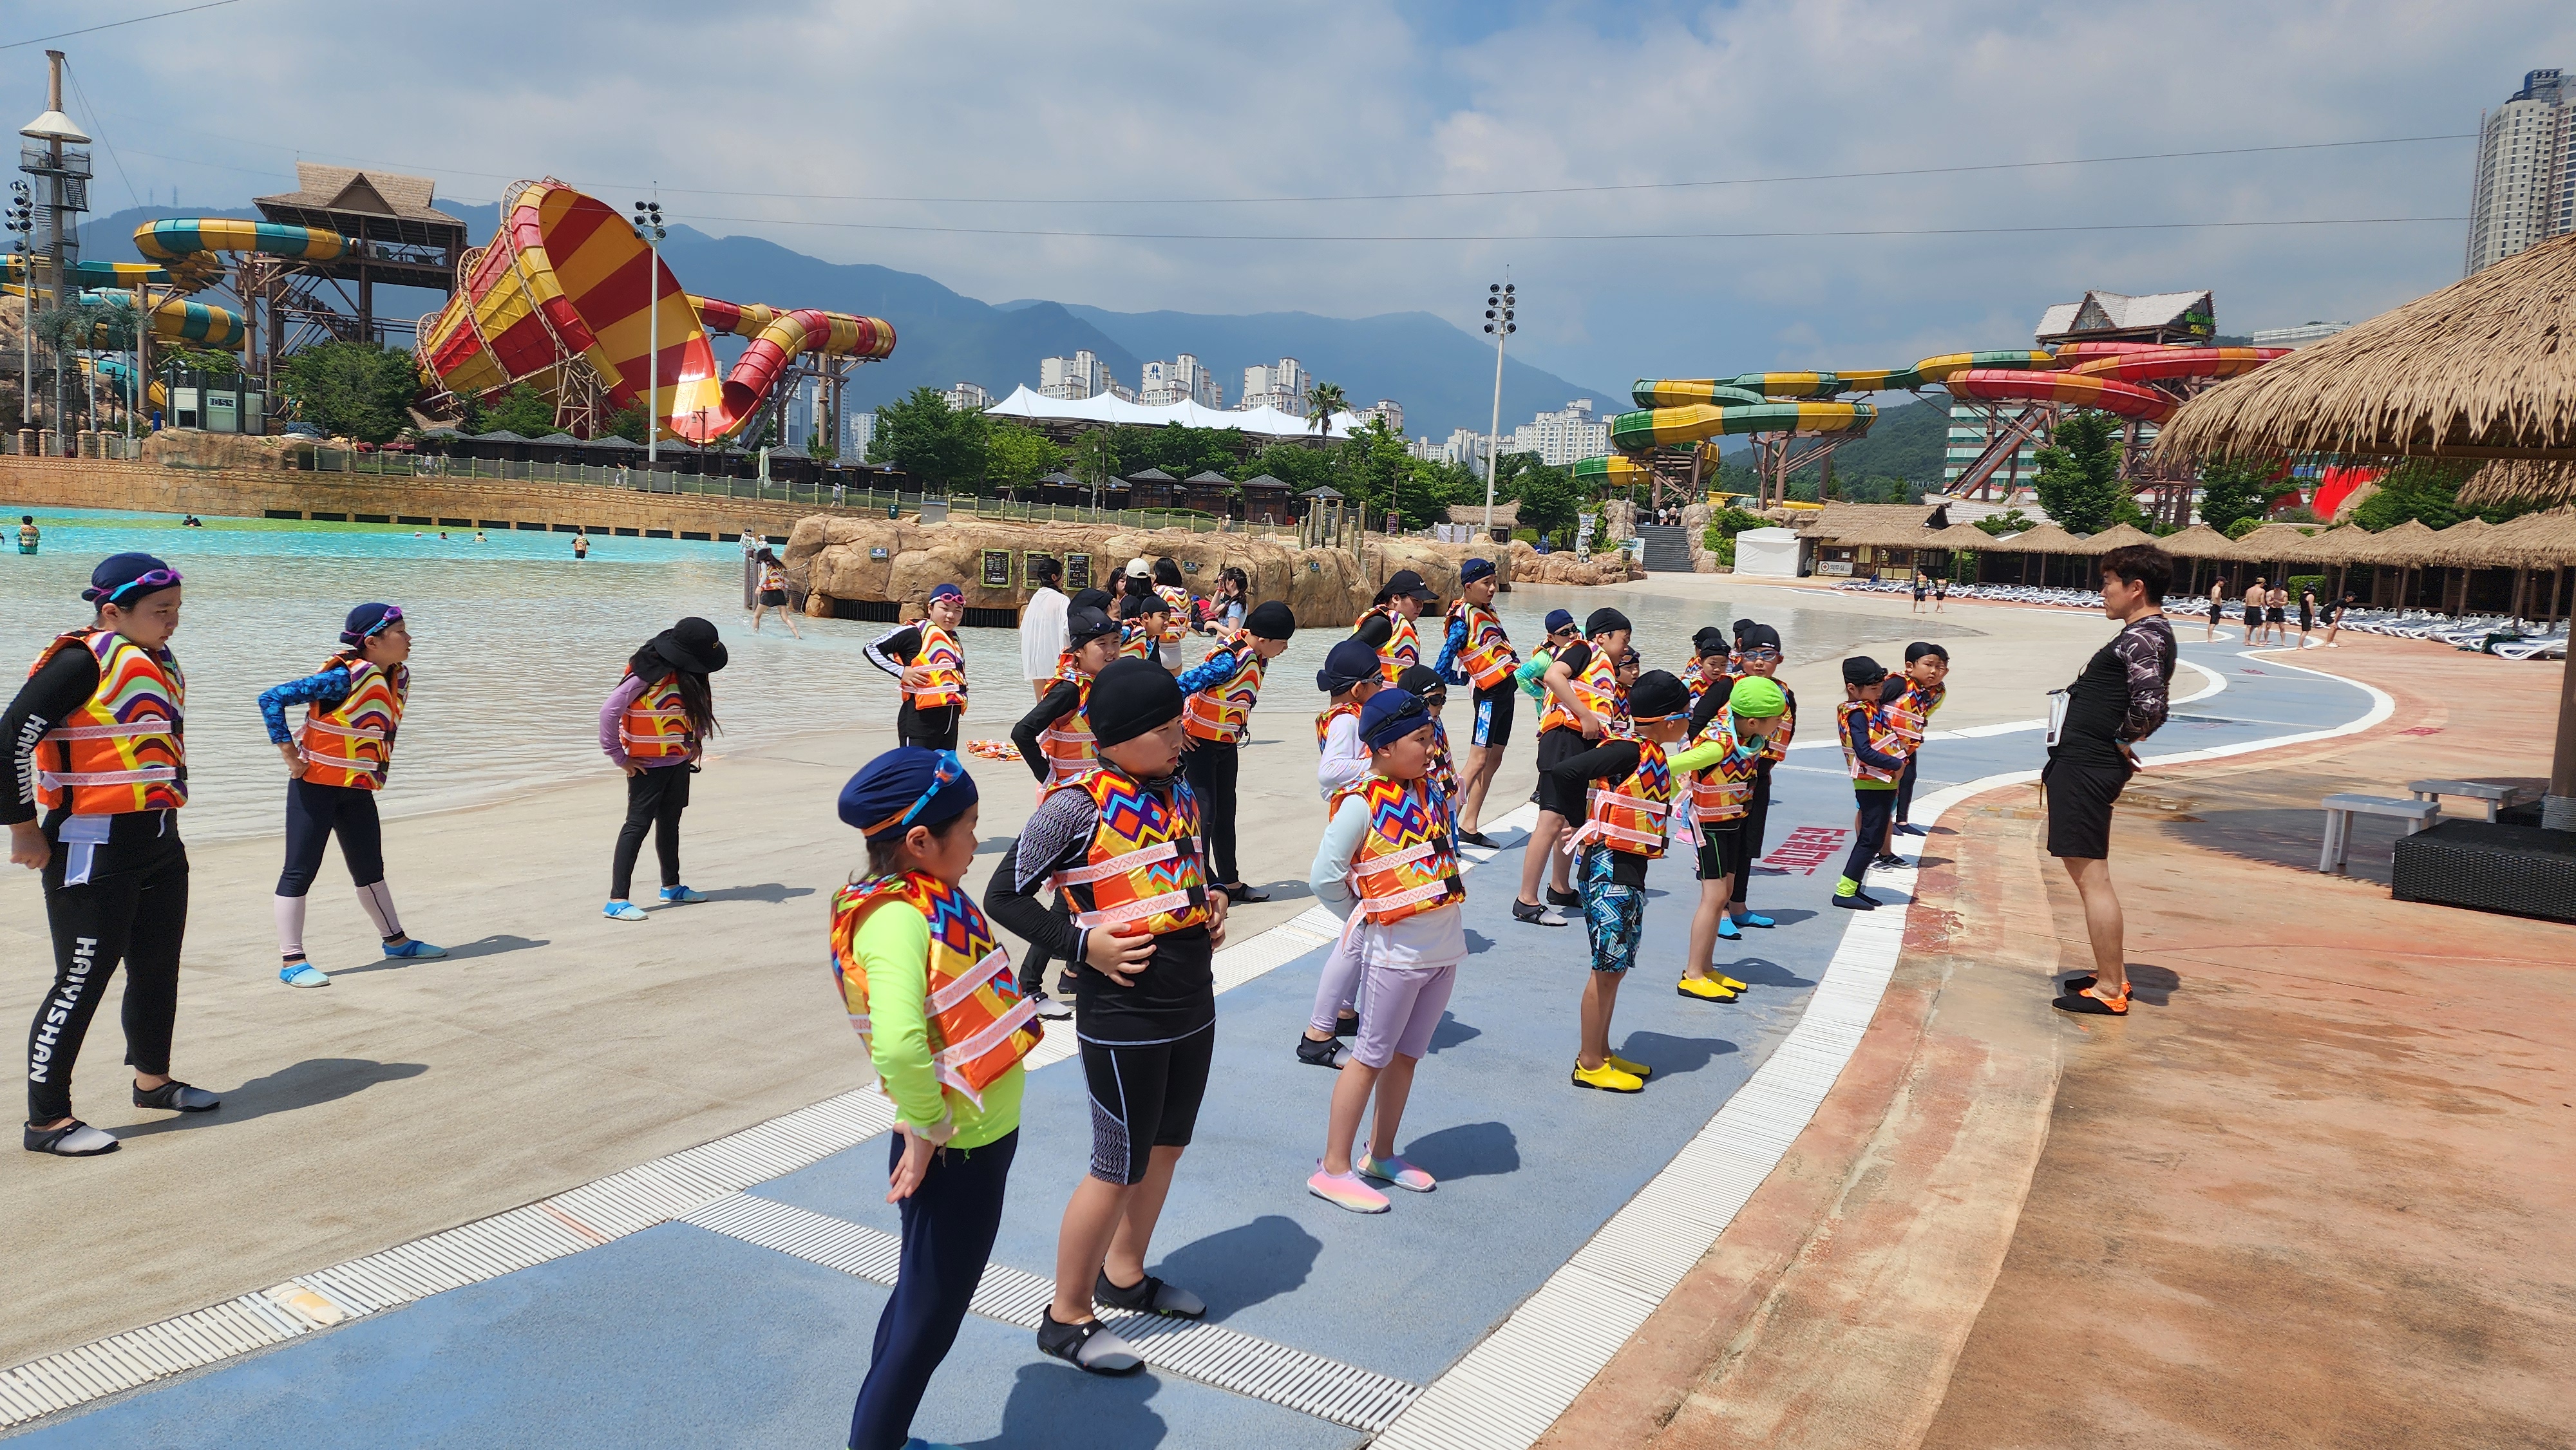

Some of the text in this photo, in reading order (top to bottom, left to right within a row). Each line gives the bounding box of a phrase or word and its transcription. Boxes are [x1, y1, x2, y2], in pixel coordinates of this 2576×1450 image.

[2185, 311, 2215, 326] Rafting
[2190, 325, 2208, 335] Slide
[30, 937, 97, 1084] HAIYISHAN
